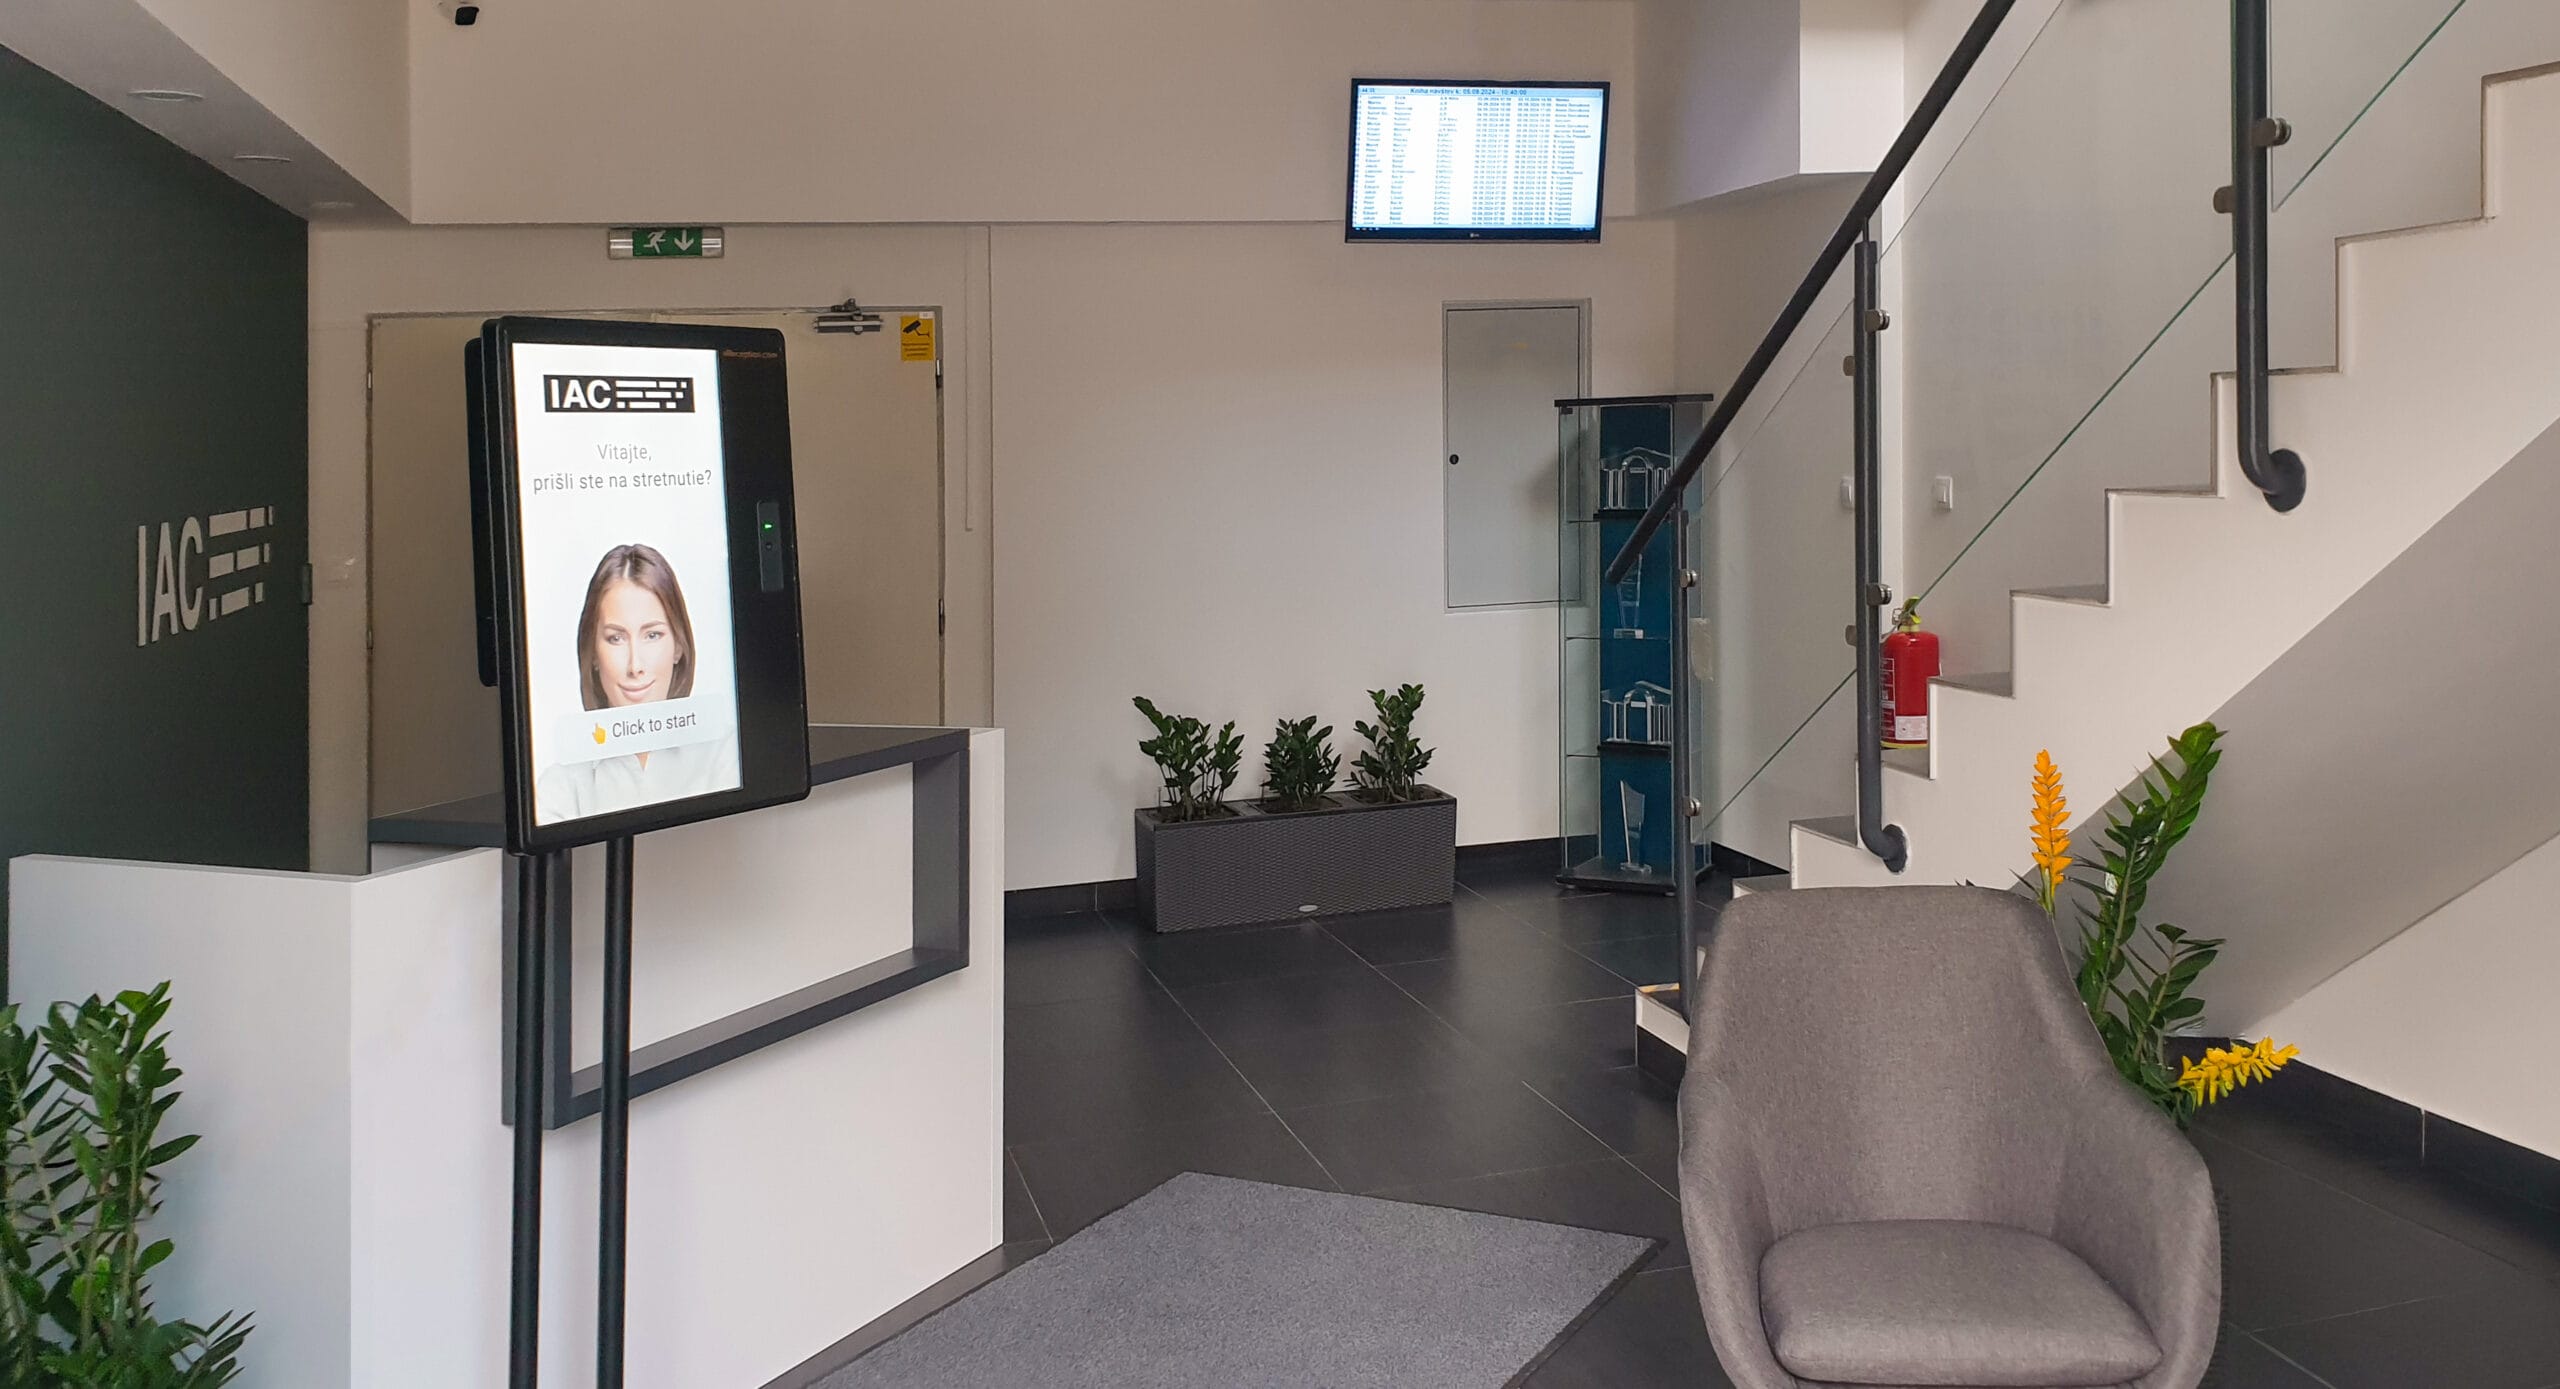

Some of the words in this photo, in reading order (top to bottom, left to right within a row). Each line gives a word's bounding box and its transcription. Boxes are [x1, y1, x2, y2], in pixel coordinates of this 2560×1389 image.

[551, 379, 611, 409] IAC
[597, 444, 652, 464] Vitajte,
[533, 473, 573, 495] prišli
[579, 474, 604, 489] ste
[609, 475, 628, 488] na
[633, 469, 712, 488] stretnutie?
[138, 516, 204, 647] IAC
[612, 719, 646, 738] Click
[649, 718, 662, 732] to
[666, 712, 697, 730] start
